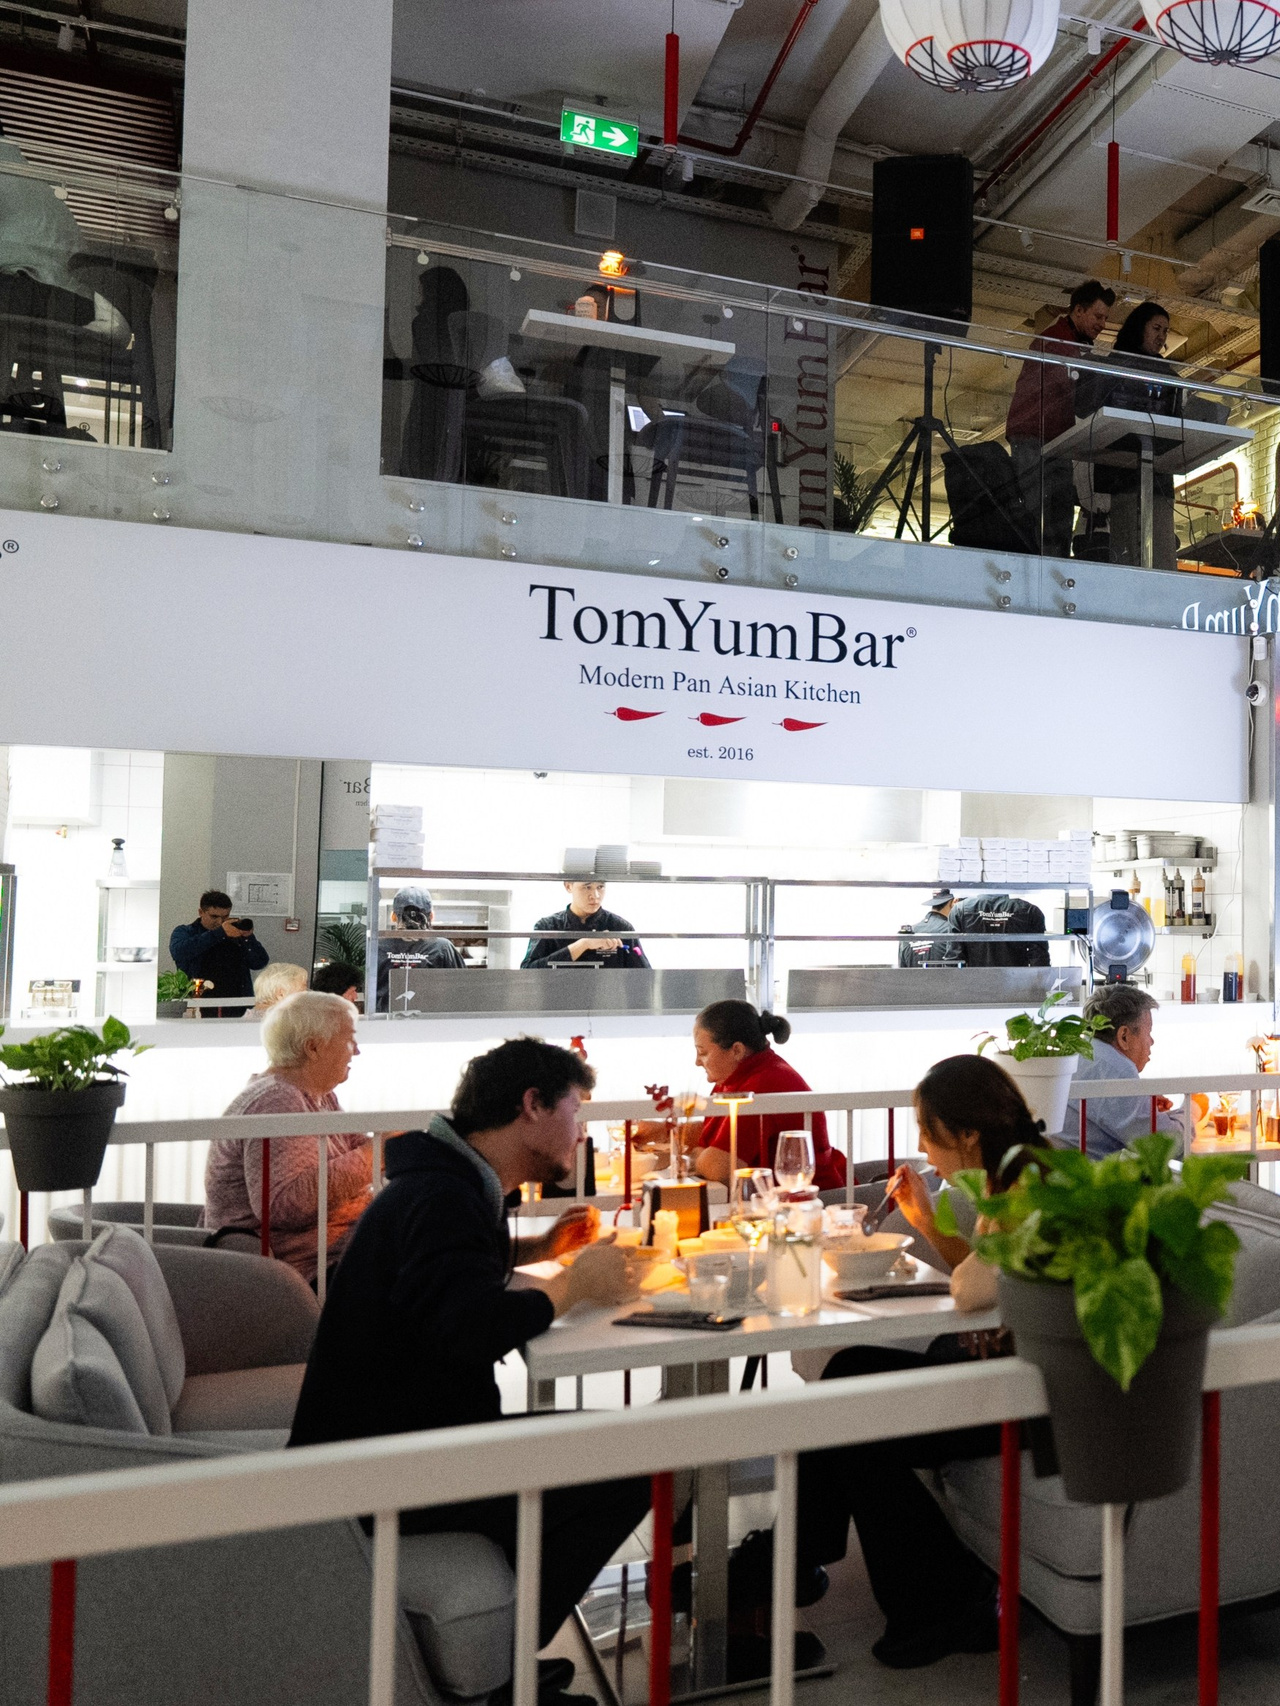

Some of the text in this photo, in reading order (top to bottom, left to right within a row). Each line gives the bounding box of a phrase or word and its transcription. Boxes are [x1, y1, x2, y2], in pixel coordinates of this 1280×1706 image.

[579, 664, 861, 704] Modern Pan Asian Kitchen
[687, 746, 754, 761] est. 2016
